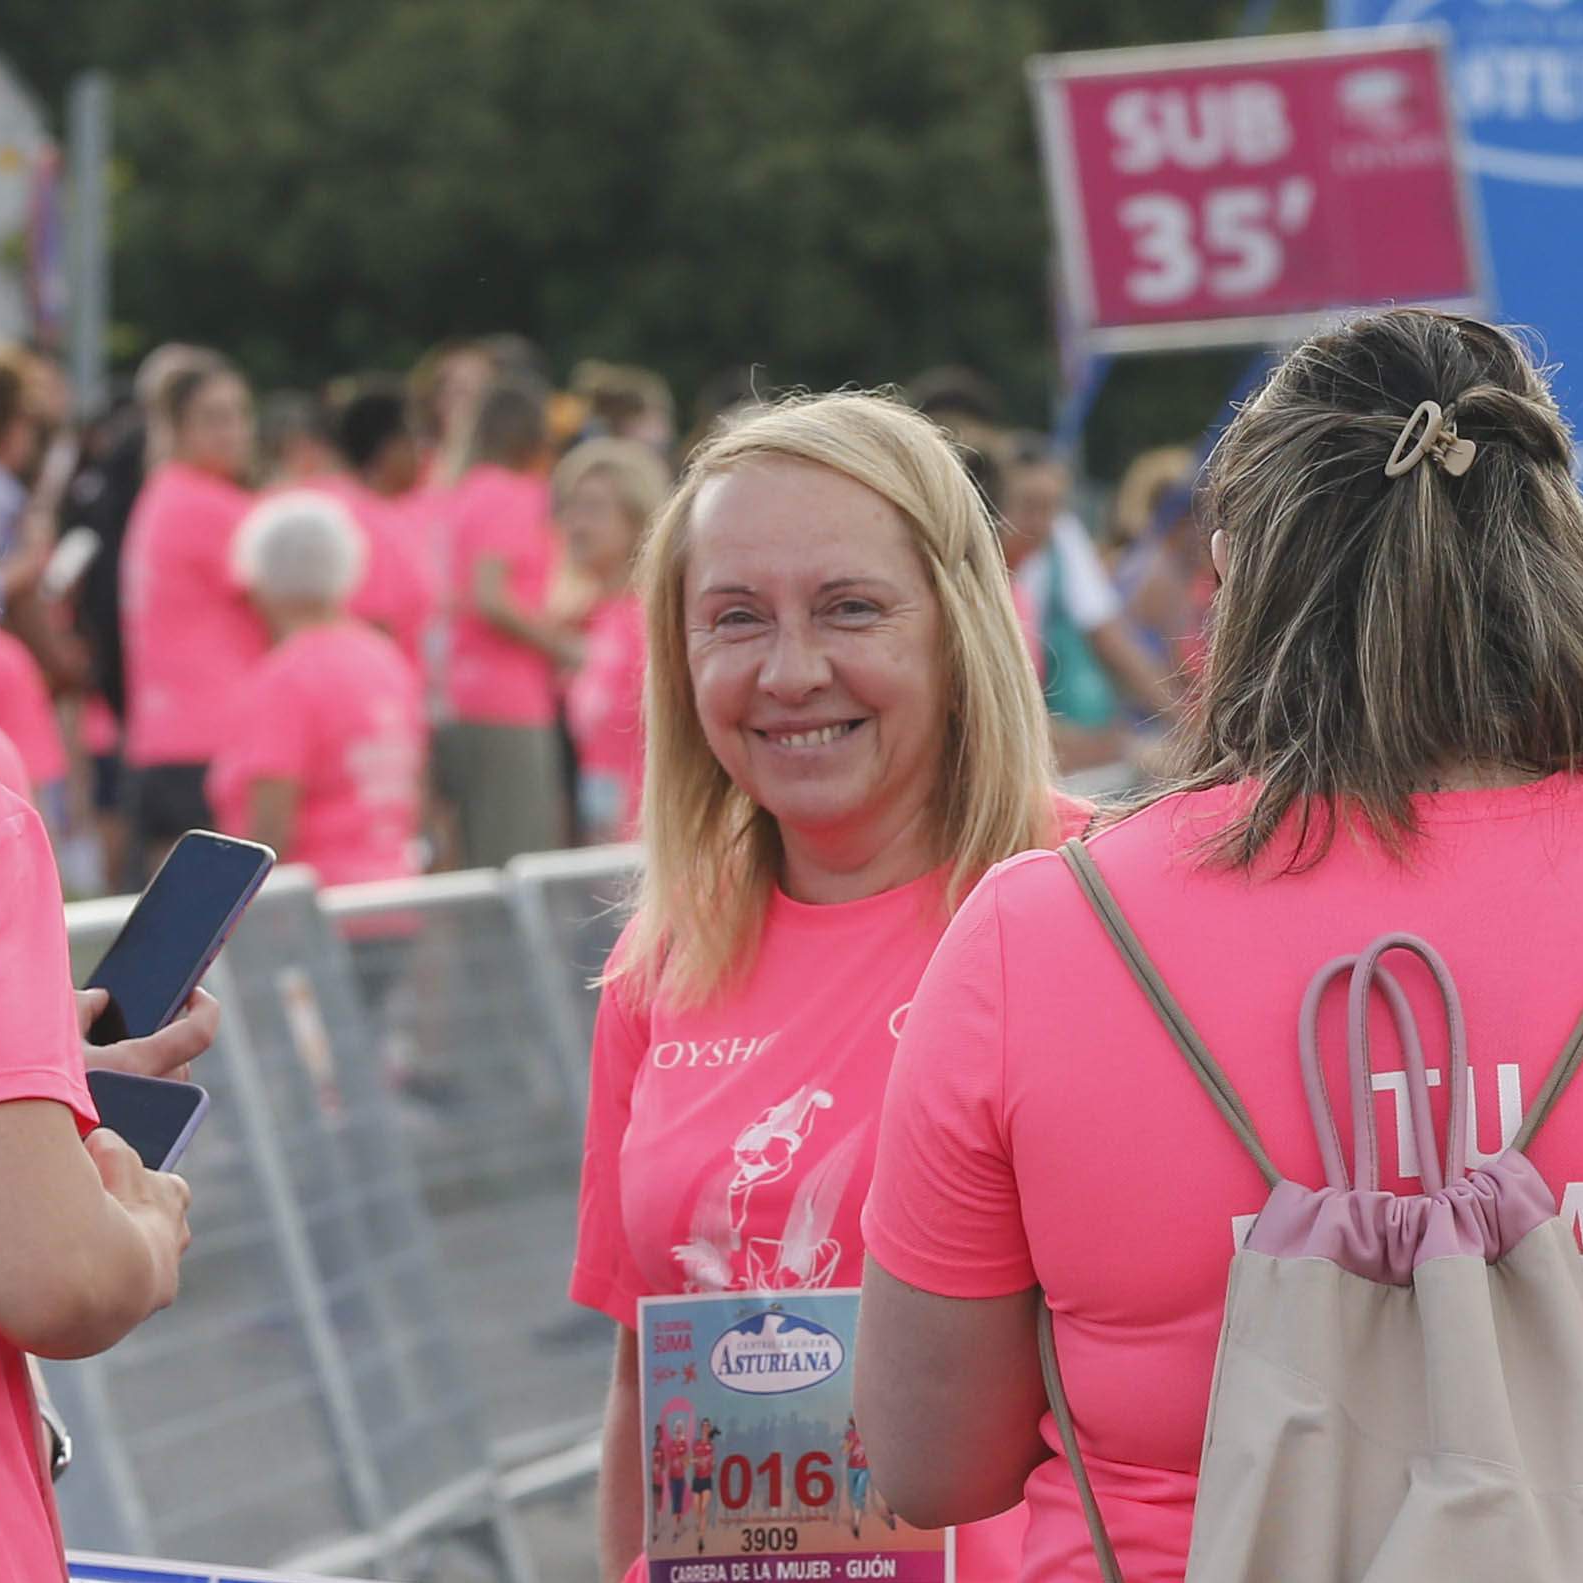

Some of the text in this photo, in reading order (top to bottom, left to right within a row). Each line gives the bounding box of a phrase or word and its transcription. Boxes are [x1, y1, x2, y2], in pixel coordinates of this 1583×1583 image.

[1105, 80, 1290, 176] SUB
[1371, 1063, 1525, 1179] TU
[718, 1344, 832, 1375] ASTURIANA
[719, 1451, 835, 1510] 016
[740, 1526, 799, 1552] 3909
[731, 1561, 750, 1581] DE
[752, 1560, 771, 1580] LA
[776, 1560, 832, 1580] MUJER
[845, 1554, 897, 1578] GIJÓN
